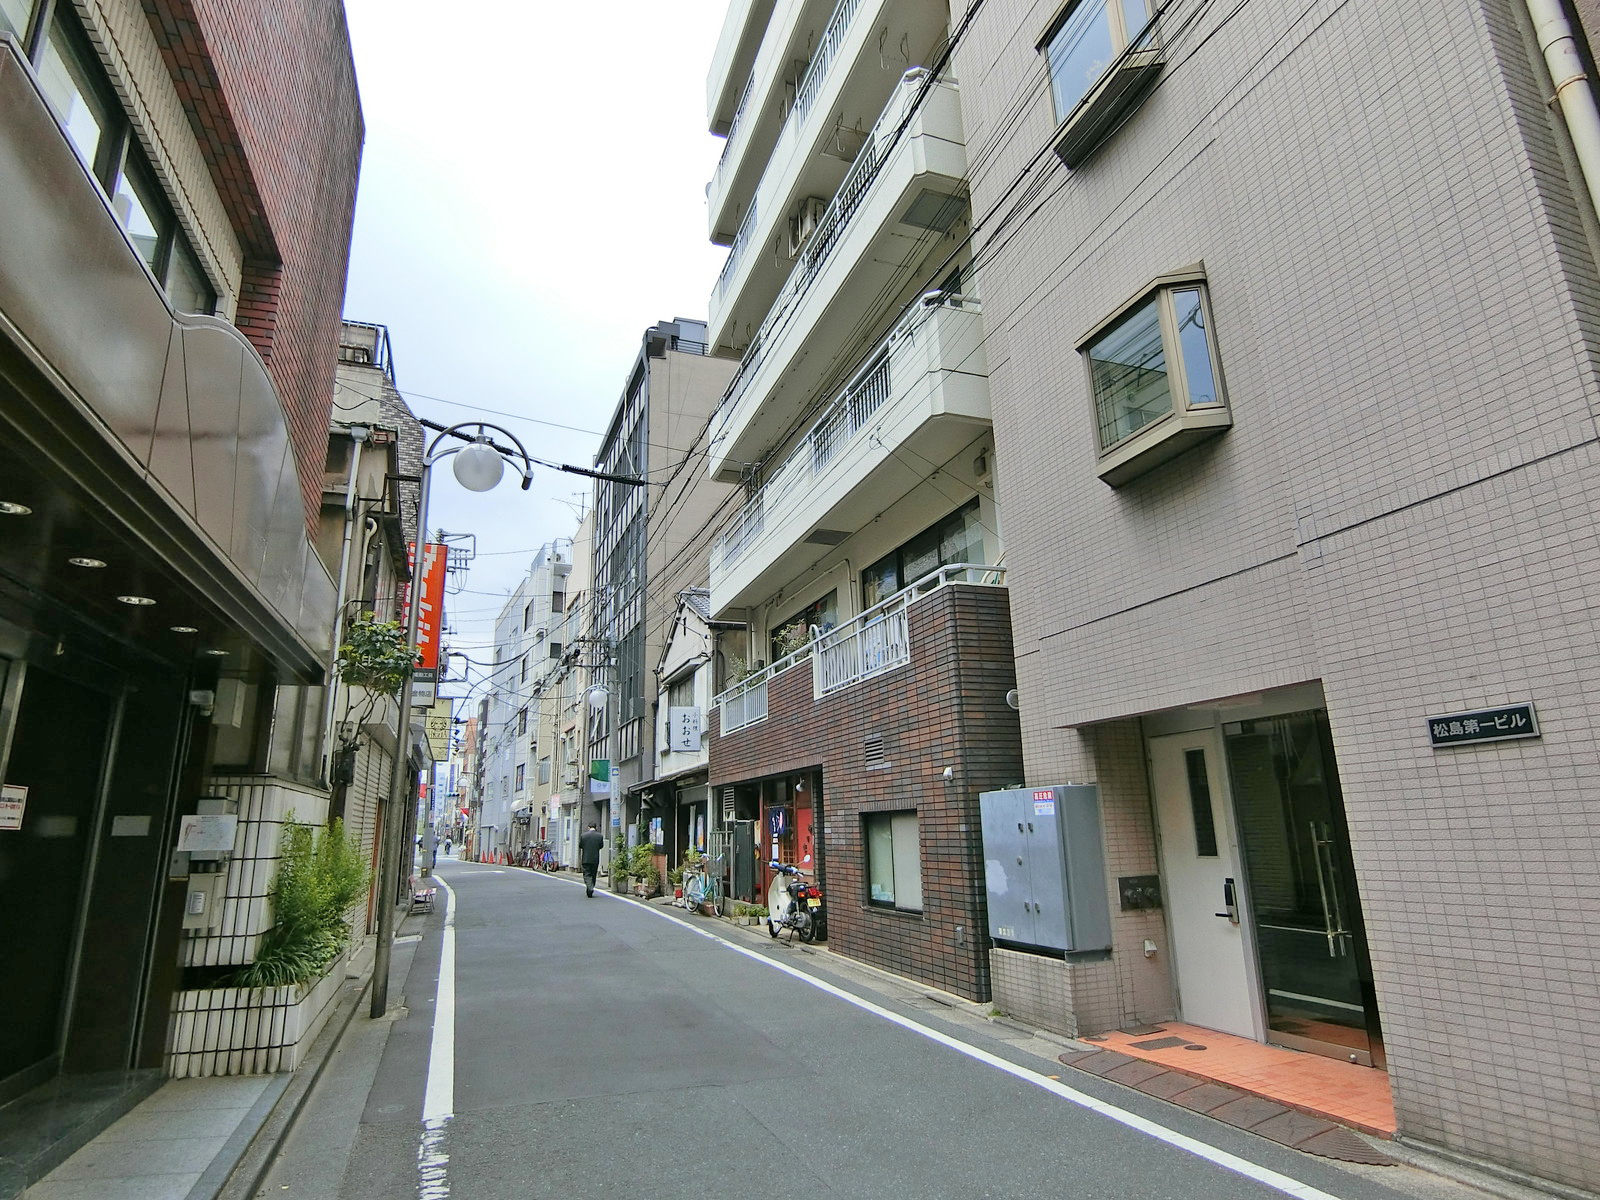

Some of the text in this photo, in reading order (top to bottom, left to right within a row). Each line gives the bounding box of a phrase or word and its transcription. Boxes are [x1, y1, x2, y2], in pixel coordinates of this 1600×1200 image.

[681, 713, 691, 747] おおせ
[1432, 713, 1527, 738] 松島第一ビル
